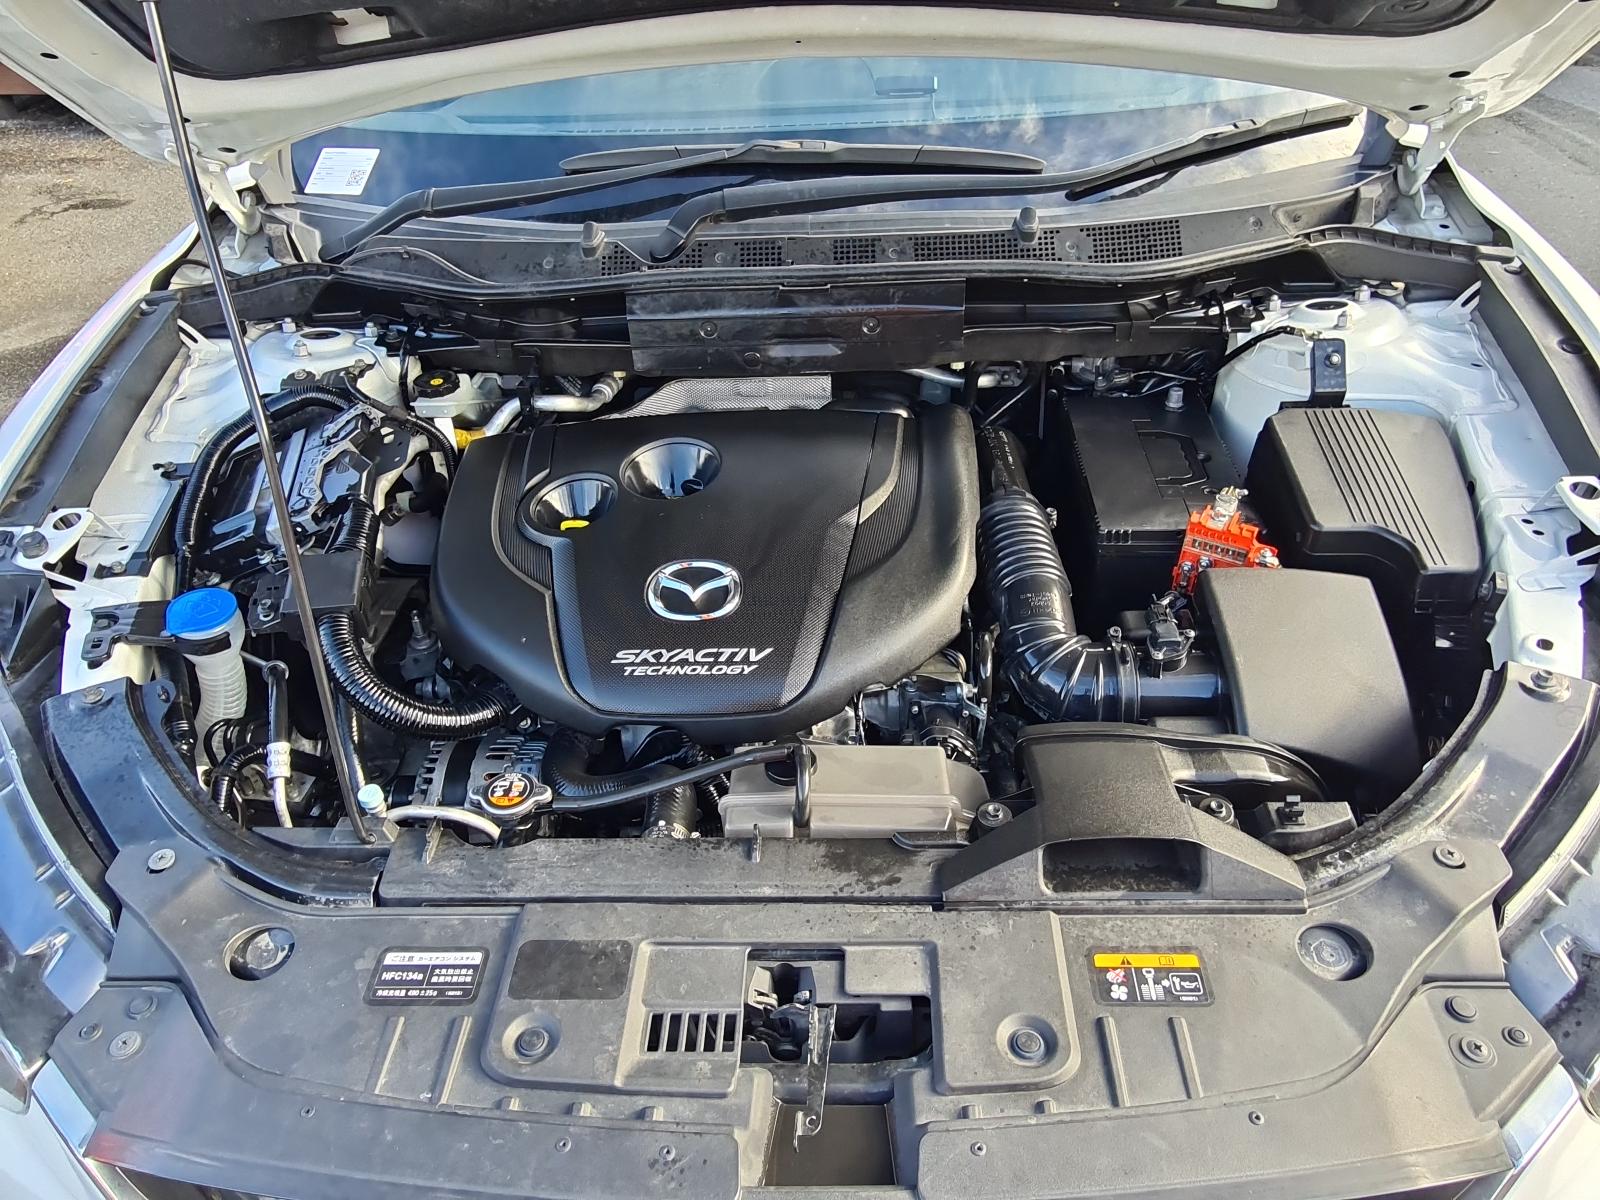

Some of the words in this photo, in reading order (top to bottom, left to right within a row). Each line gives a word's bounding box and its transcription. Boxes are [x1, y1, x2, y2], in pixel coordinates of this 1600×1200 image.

[610, 647, 774, 663] SKYACTIV
[623, 664, 759, 676] TECHNOLOGY
[381, 971, 424, 981] HFC134a
